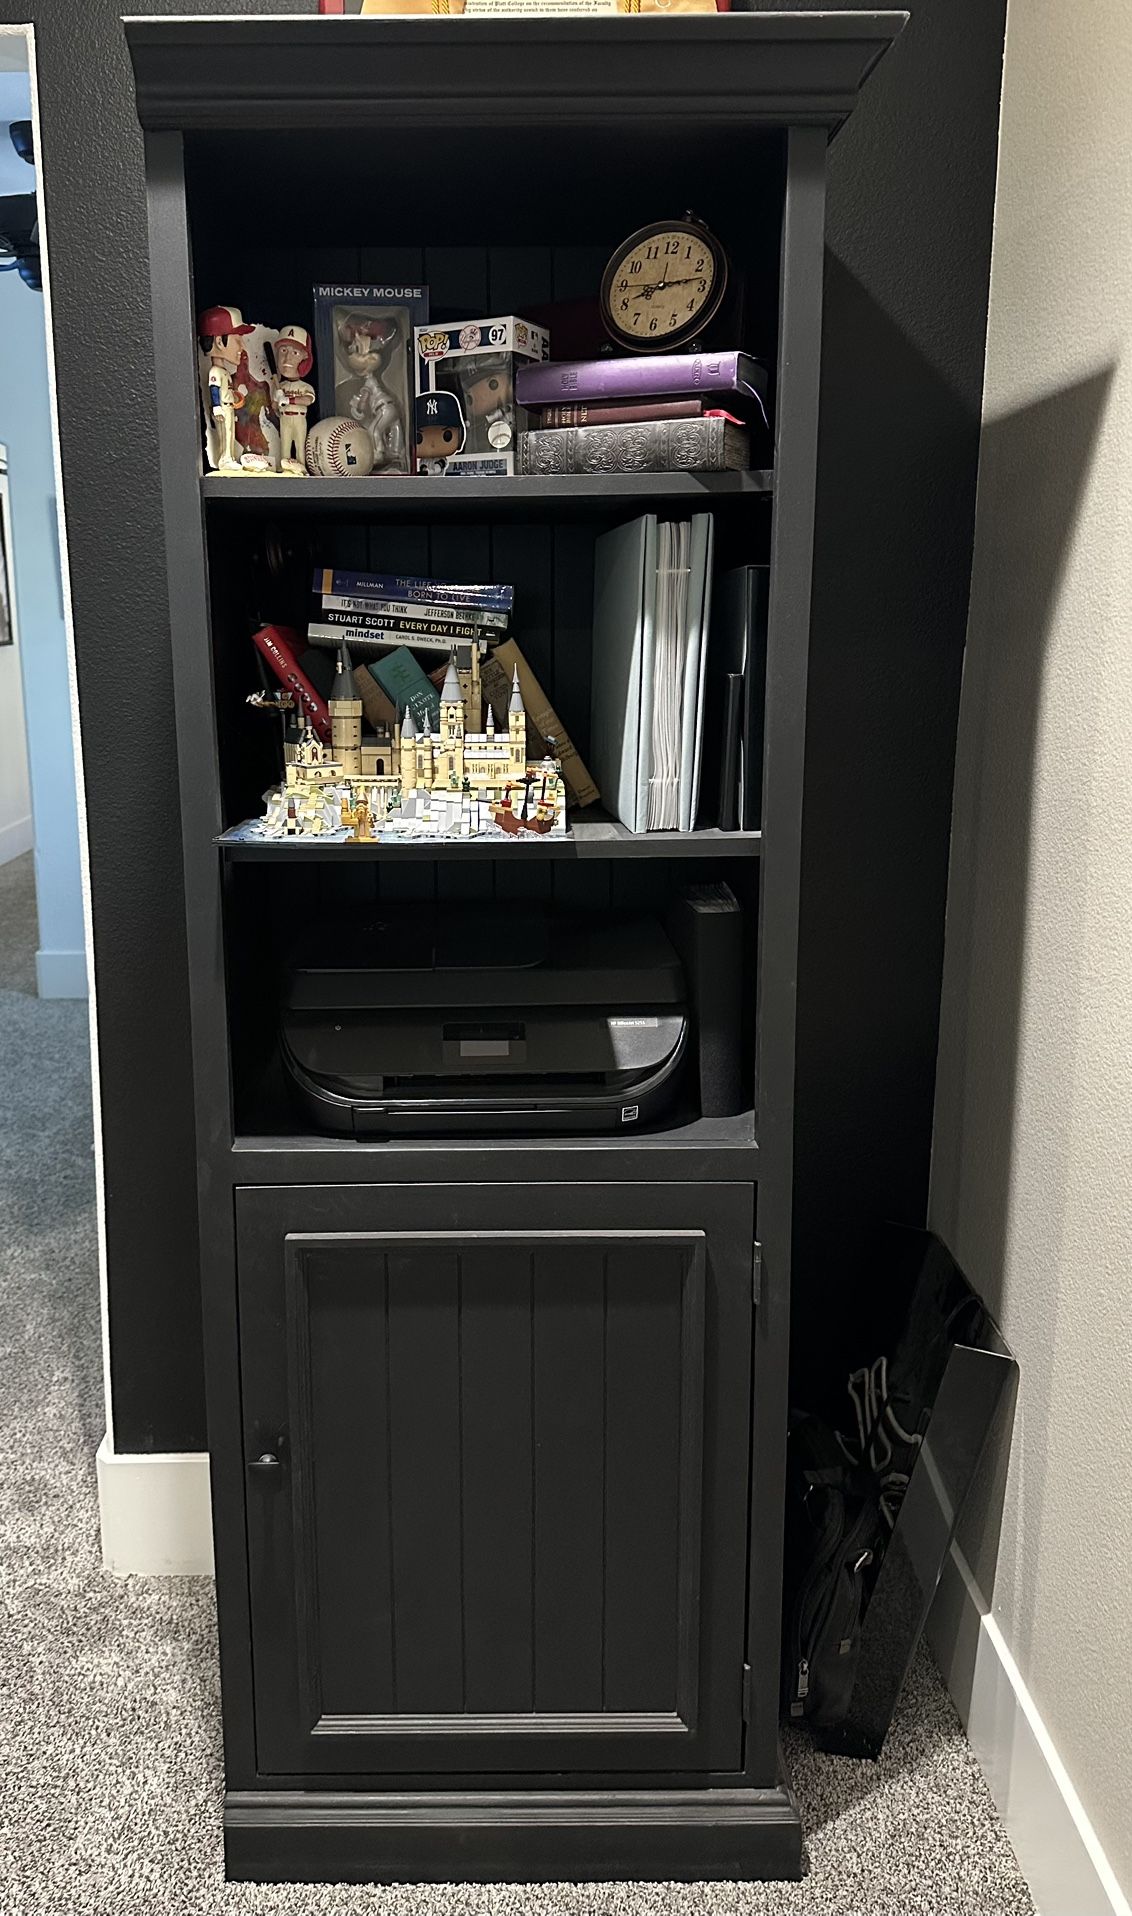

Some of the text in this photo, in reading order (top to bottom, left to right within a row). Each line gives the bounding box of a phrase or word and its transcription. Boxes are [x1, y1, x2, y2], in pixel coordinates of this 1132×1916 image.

[645, 246, 660, 260] 11
[664, 241, 680, 255] 12
[684, 246, 692, 260] 1
[629, 260, 642, 274] 10
[695, 259, 704, 272] 2
[619, 280, 628, 292] 9
[697, 279, 706, 292] 3
[318, 287, 422, 298] MICKEY MOUSE
[620, 298, 630, 311] 8
[686, 298, 695, 312] 4
[633, 312, 641, 326] 7
[649, 318, 658, 331] 6
[669, 314, 678, 327] 5
[288, 328, 295, 337] A
[491, 328, 504, 341] 97
[417, 332, 449, 353] POP!
[426, 398, 438, 415] NY
[453, 460, 504, 471] AARON JUDGE
[396, 578, 412, 588] THE
[414, 581, 431, 590] LIFE
[408, 590, 471, 602] BORN TO LIVE
[352, 600, 362, 610] NOT
[364, 601, 378, 611] WHAT
[380, 602, 390, 612] YOU
[392, 604, 408, 614] THINK
[424, 608, 454, 618] JEFFERSON
[328, 613, 363, 624] STUART
[366, 617, 396, 628] SCOTT
[400, 620, 428, 630] EVERY
[430, 624, 448, 632] DAY
[450, 626, 454, 634] I
[346, 628, 384, 640] mindset
[263, 637, 288, 669] JIM COLLINS
